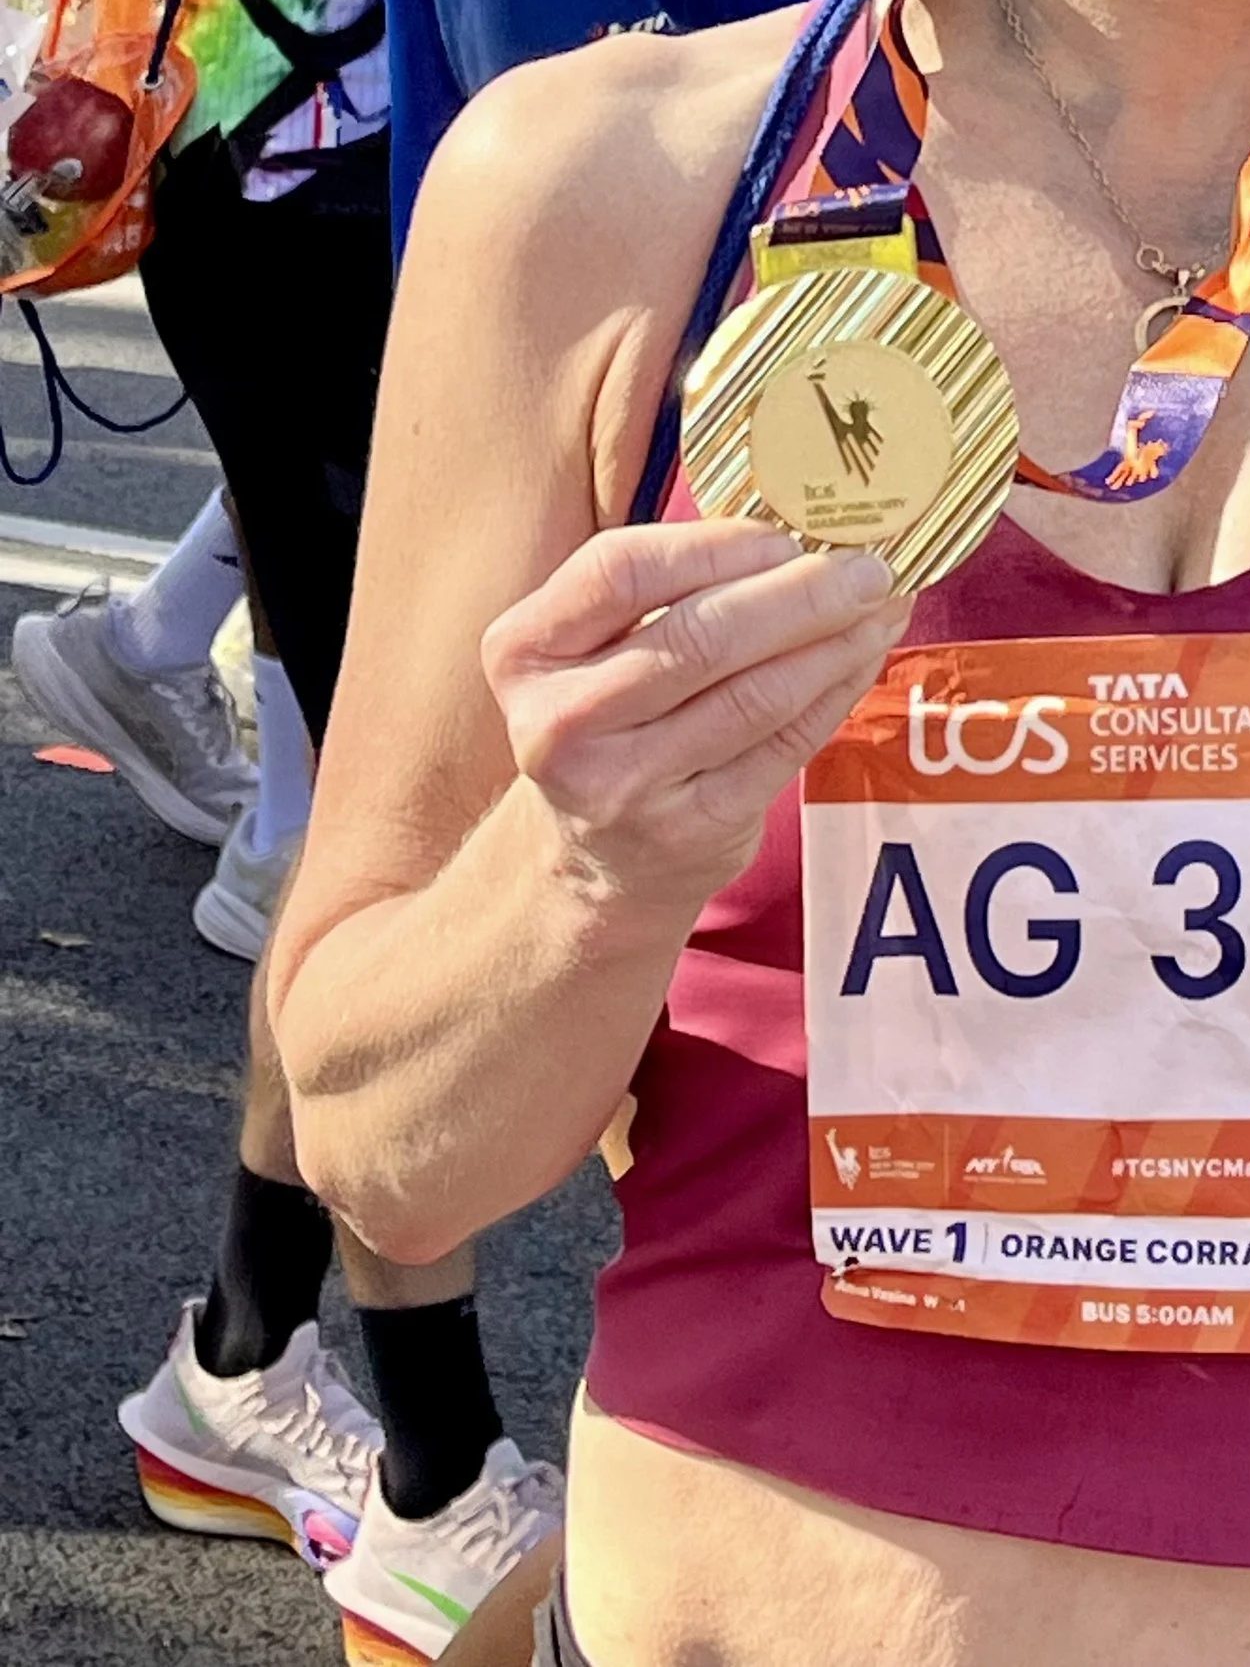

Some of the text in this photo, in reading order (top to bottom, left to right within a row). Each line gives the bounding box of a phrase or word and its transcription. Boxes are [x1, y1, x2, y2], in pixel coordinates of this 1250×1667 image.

[1088, 673, 1188, 702] TATA
[909, 684, 1069, 775] tcs
[1089, 742, 1239, 774] SERVICES
[840, 841, 1082, 999] AG
[829, 1226, 933, 1254] WAVE
[945, 1221, 967, 1264] 1
[1000, 1233, 1138, 1265] ORANGE
[1081, 1301, 1235, 1326] BUS 5:00AM
